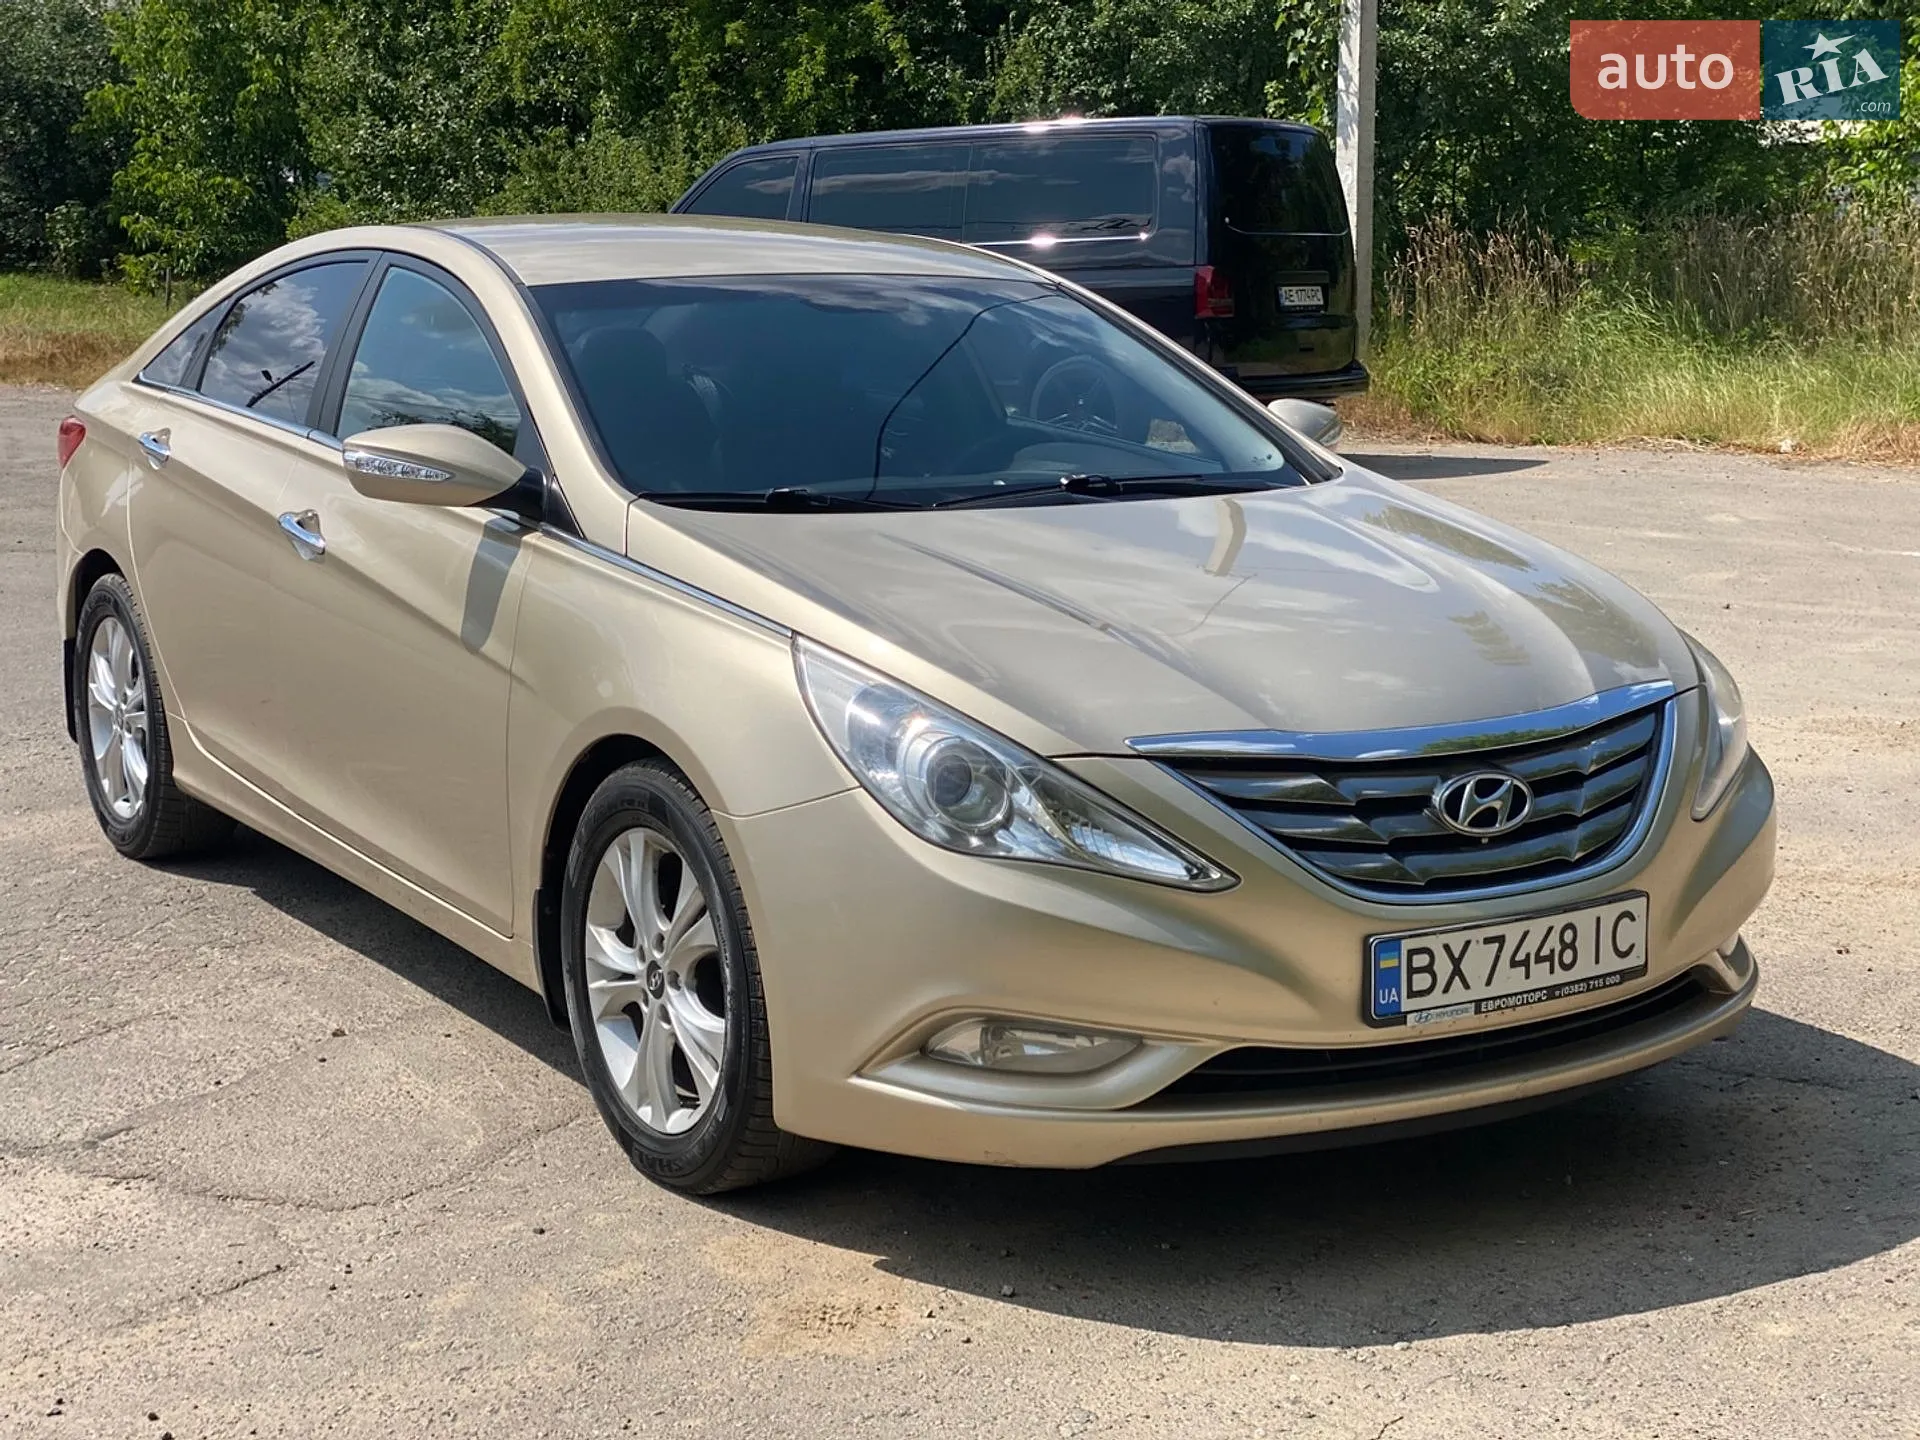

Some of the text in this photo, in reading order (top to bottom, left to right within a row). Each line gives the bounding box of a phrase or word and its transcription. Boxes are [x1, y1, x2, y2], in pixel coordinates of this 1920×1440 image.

[1406, 939, 1471, 1000] BX
[1482, 922, 1578, 988] 7448
[1379, 987, 1399, 1004] UA
